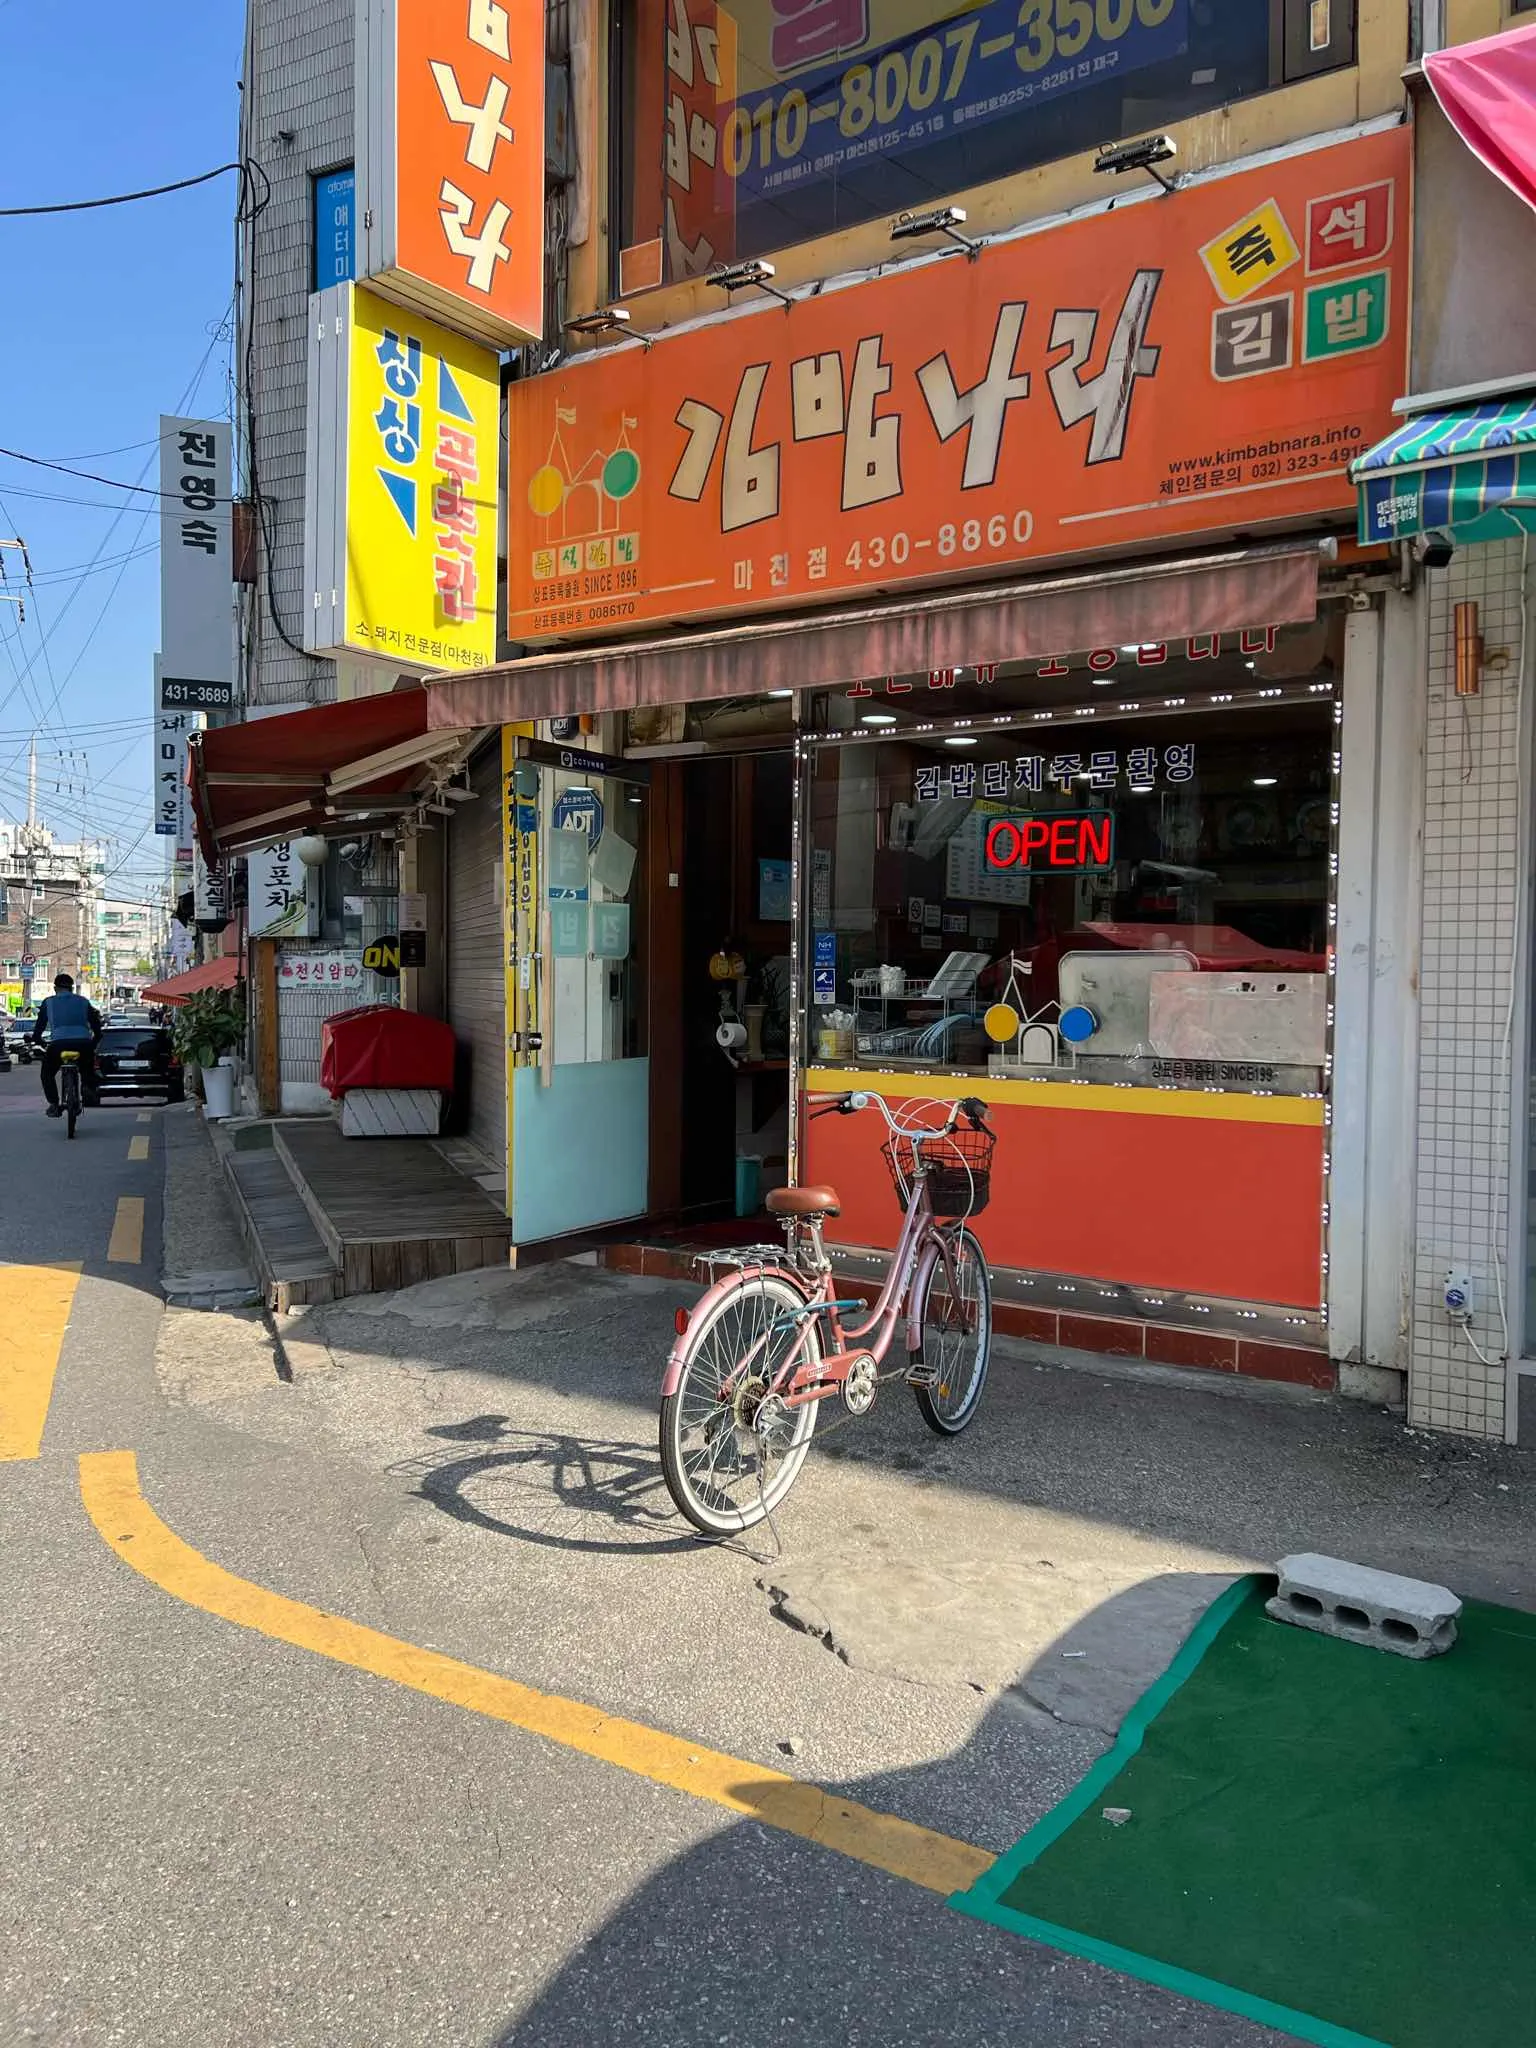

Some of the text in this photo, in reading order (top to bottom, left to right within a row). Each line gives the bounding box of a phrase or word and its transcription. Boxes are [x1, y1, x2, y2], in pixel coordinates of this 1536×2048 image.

[334, 203, 349, 277] 애터미
[375, 328, 422, 467] 싱싱
[667, 268, 1165, 534] 김밥나라
[1168, 424, 1362, 474] www.kimbabnara.info
[177, 430, 217, 555] 전영숙
[1159, 466, 1242, 495] 체인점문의
[1251, 460, 1282, 479] 032)
[845, 509, 1035, 572] 430-8860
[584, 573, 613, 595] SINCE
[616, 567, 638, 589] 1996
[588, 601, 636, 621] 0086170
[165, 684, 230, 703] 431-3689
[561, 810, 594, 833] ADT
[985, 815, 1112, 869] OPEN
